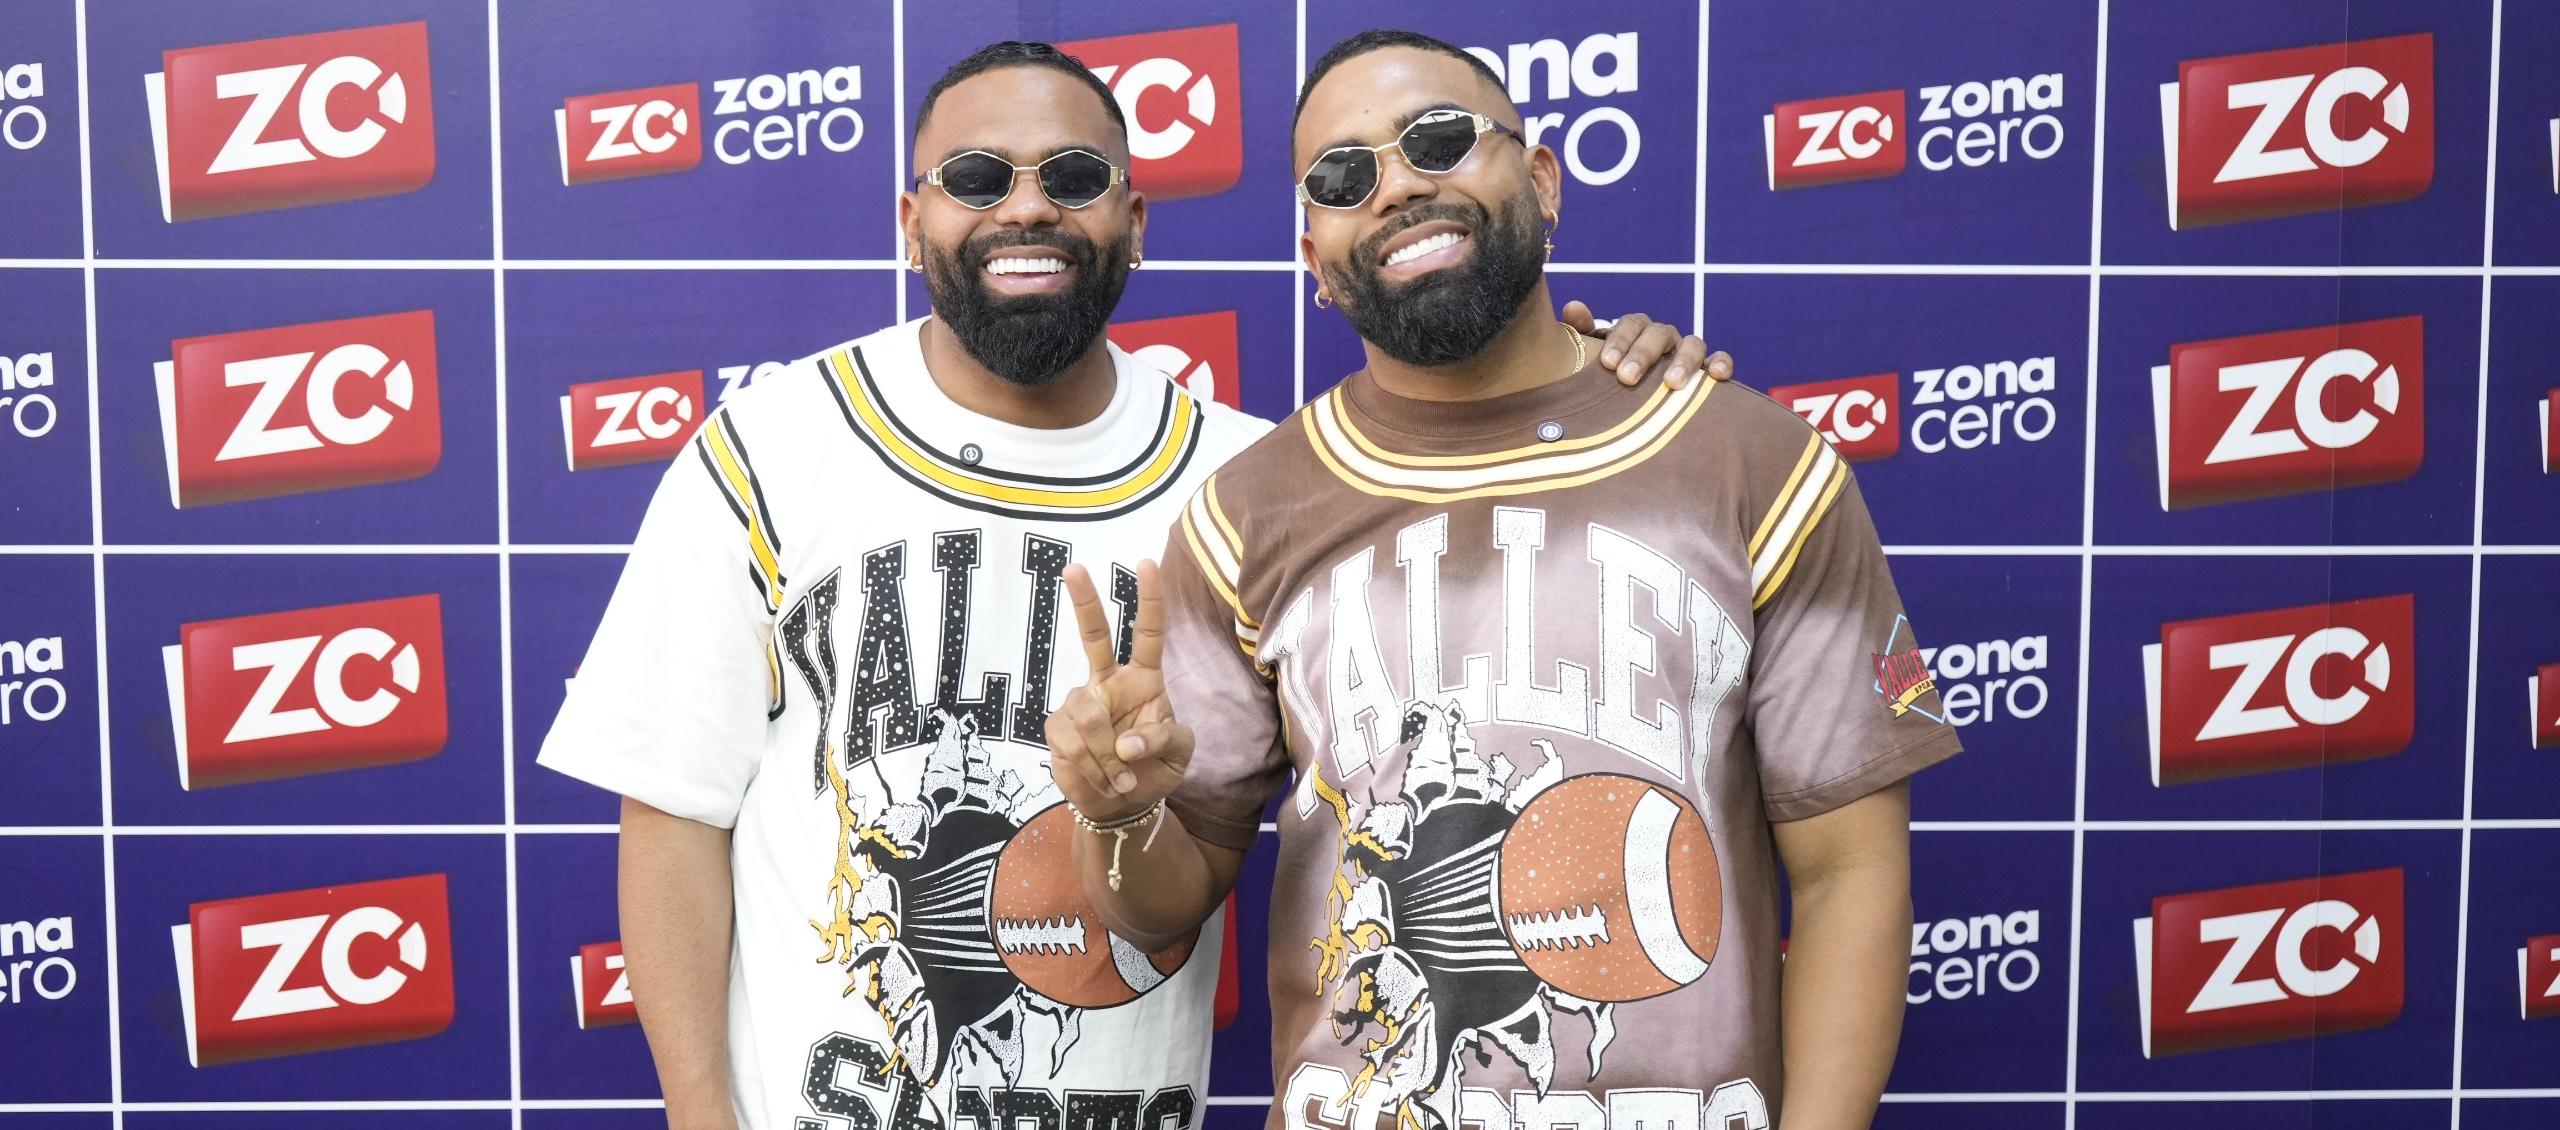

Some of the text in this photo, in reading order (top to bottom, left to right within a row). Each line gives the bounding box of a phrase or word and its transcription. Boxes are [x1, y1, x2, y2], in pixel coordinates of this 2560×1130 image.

[0, 62, 44, 100] a
[713, 65, 862, 116] zona
[1918, 73, 2064, 122] zona
[0, 104, 47, 150] o
[206, 55, 407, 175] ZC
[585, 99, 688, 162] ZC
[713, 107, 864, 165] cero
[1792, 106, 1893, 167] ZC
[1917, 114, 2064, 171] cero
[2213, 66, 2410, 183] ZC
[214, 343, 414, 462] ZC
[1912, 356, 2055, 405] zona
[2204, 348, 2400, 465] ZC
[590, 386, 693, 448] ZC
[1911, 397, 2056, 454] cero
[223, 627, 420, 744] ZC
[1937, 675, 2048, 727] ero
[2195, 627, 2390, 741] ZC
[1911, 910, 2040, 956] zona
[2186, 900, 2380, 1013] ZC
[232, 906, 427, 1022] ZC
[1906, 949, 2040, 1005] cero
